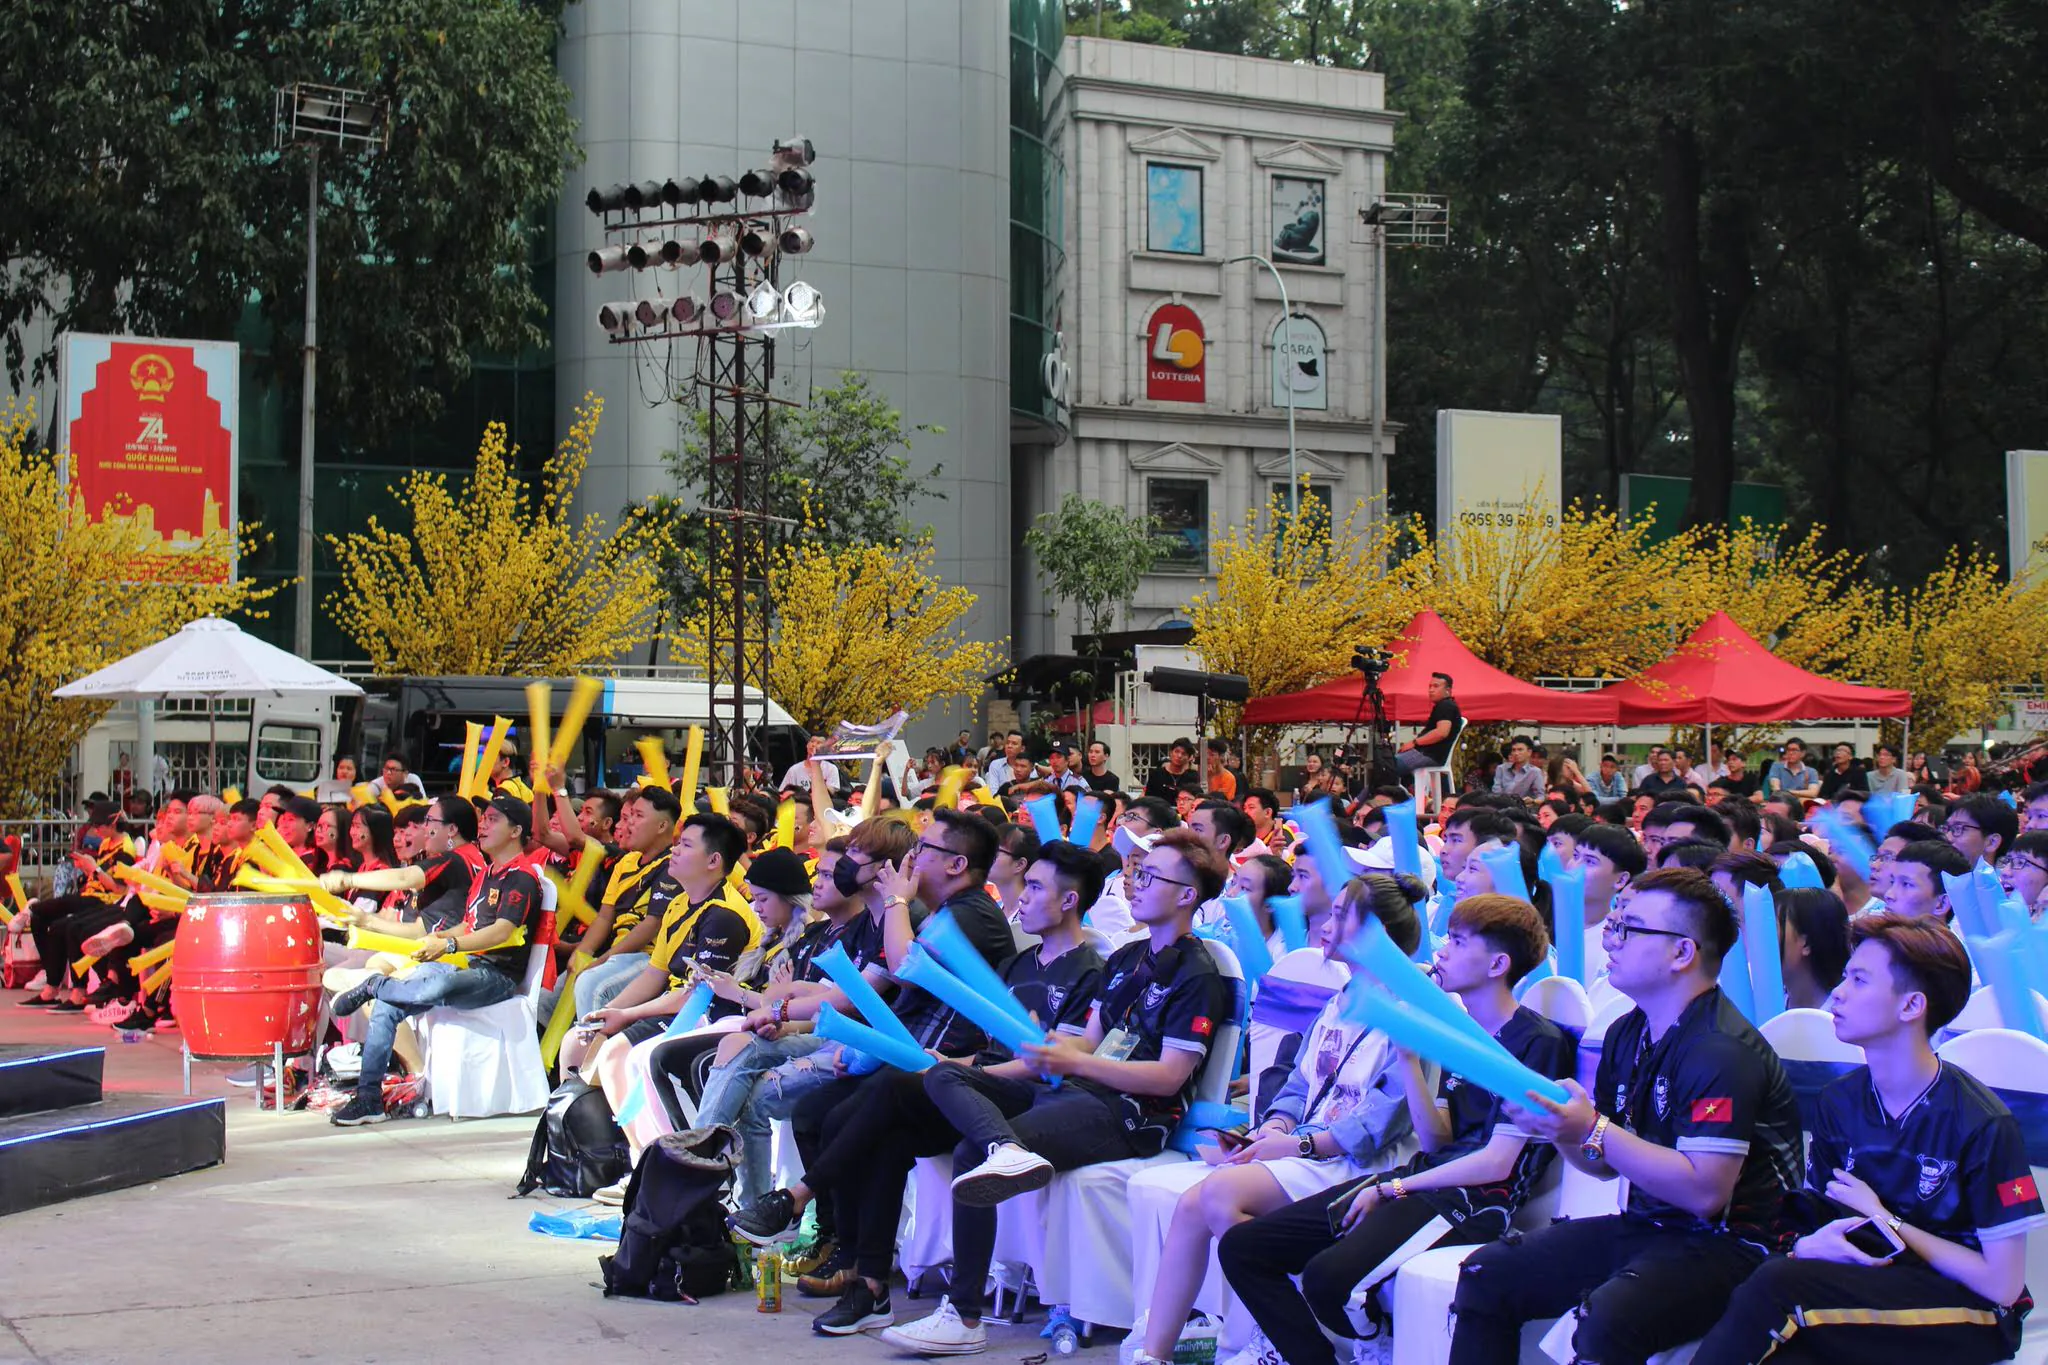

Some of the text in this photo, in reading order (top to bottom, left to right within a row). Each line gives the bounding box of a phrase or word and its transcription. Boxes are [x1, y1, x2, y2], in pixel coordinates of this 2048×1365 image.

[1280, 343, 1315, 356] CARA
[1151, 371, 1201, 382] LOTTERIA
[136, 416, 168, 445] 74
